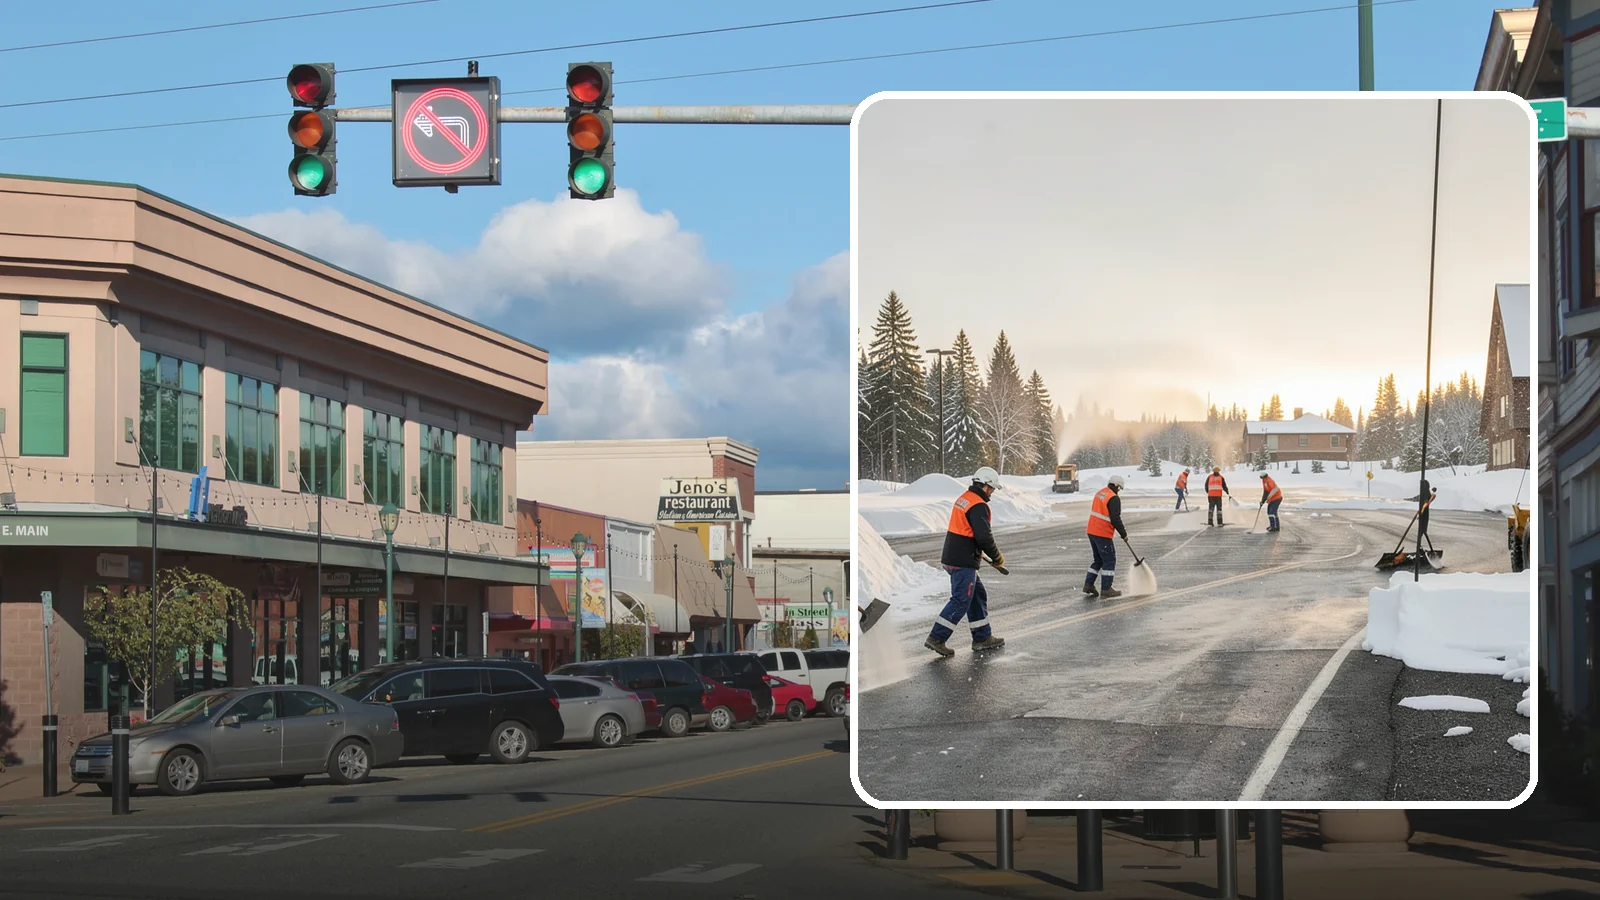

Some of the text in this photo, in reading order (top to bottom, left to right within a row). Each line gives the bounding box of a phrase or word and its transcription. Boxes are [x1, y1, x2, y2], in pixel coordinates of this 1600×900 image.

[669, 479, 728, 495] Jeno's
[665, 496, 731, 509] restaurant
[658, 509, 682, 519] Italian
[686, 509, 715, 519] American
[715, 509, 737, 519] Cuisine
[2, 525, 49, 536] E. MAIN
[797, 607, 828, 617] Street
